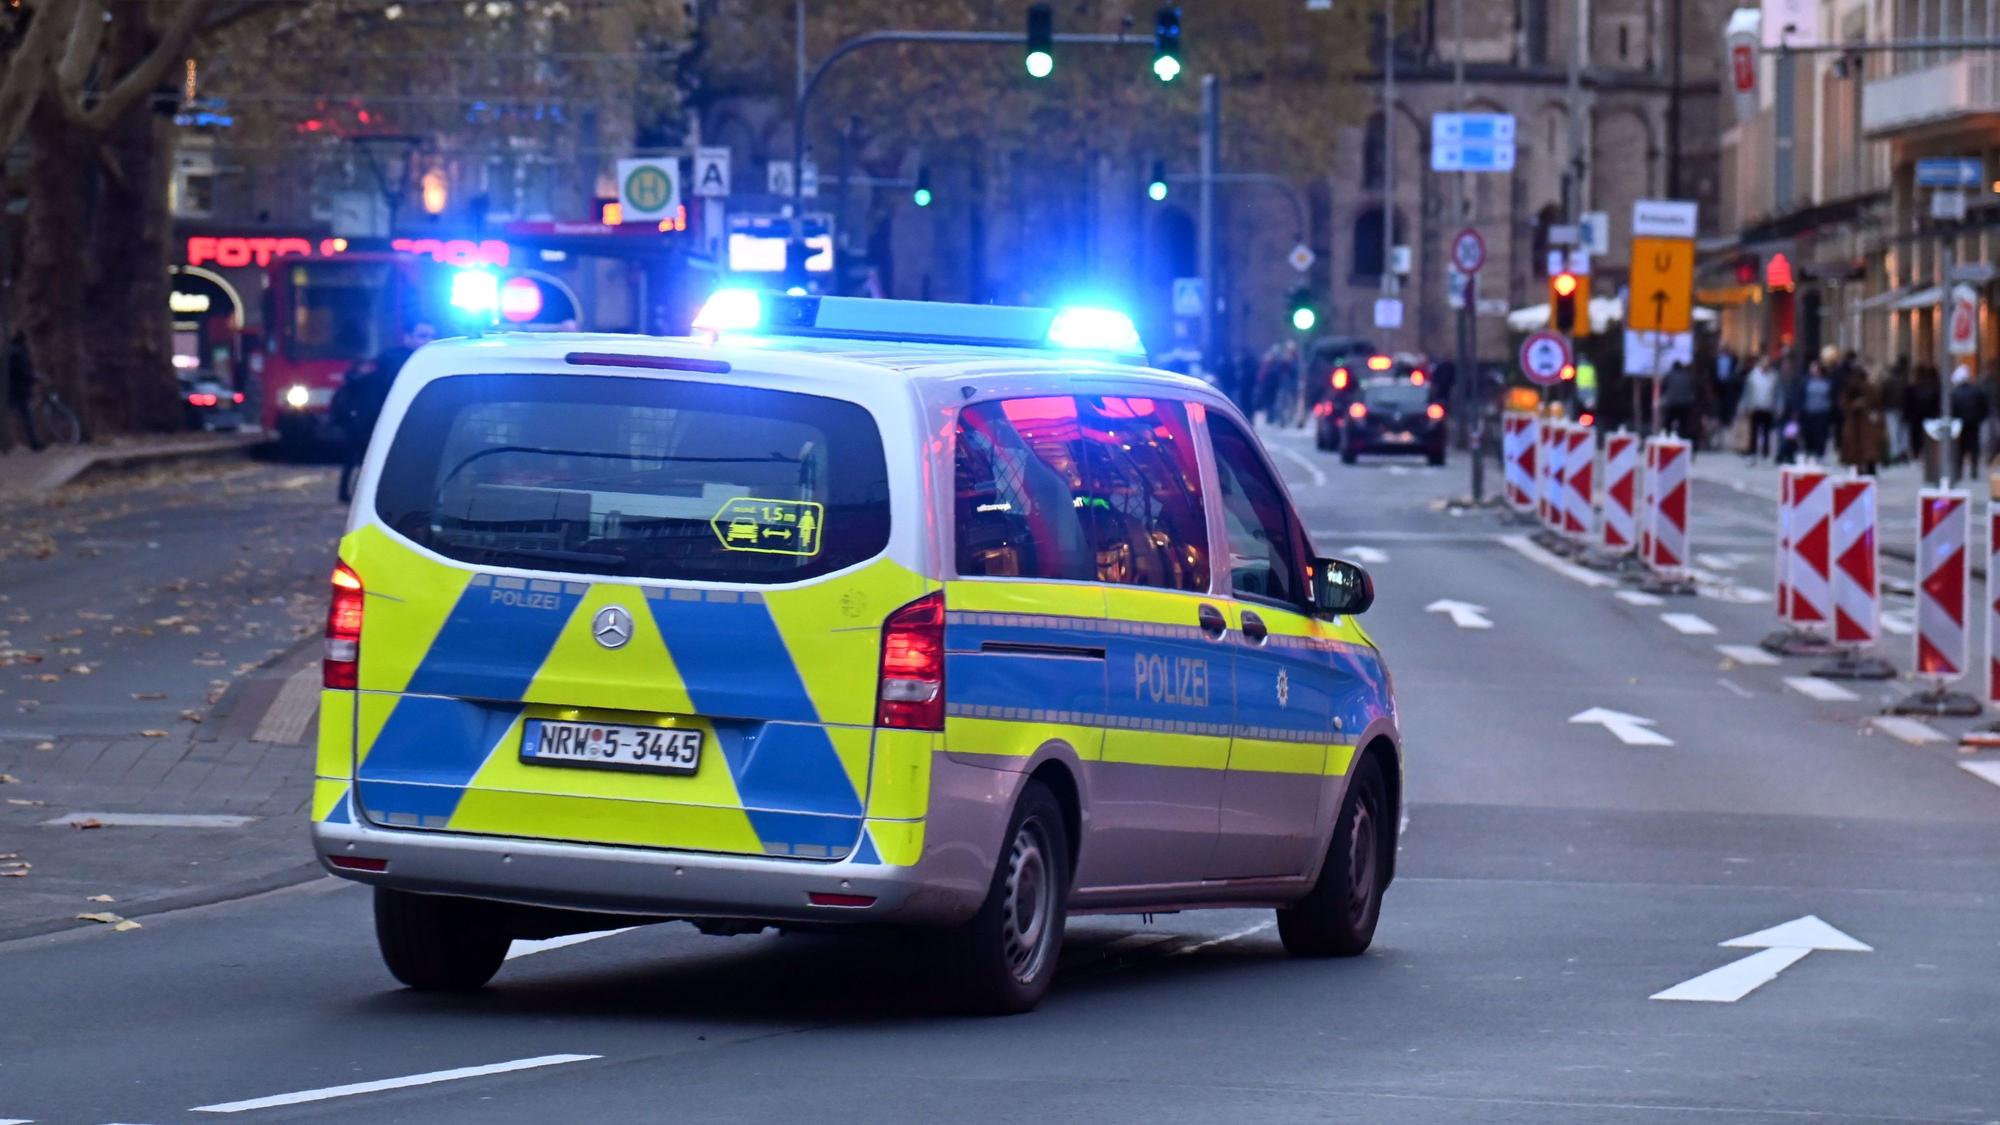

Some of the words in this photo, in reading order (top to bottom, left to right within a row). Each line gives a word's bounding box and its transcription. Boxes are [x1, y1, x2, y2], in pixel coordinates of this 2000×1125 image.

[702, 162, 724, 187] A
[1655, 251, 1672, 273] U
[490, 589, 560, 610] POLIZEI
[1135, 652, 1209, 707] POLIZEI
